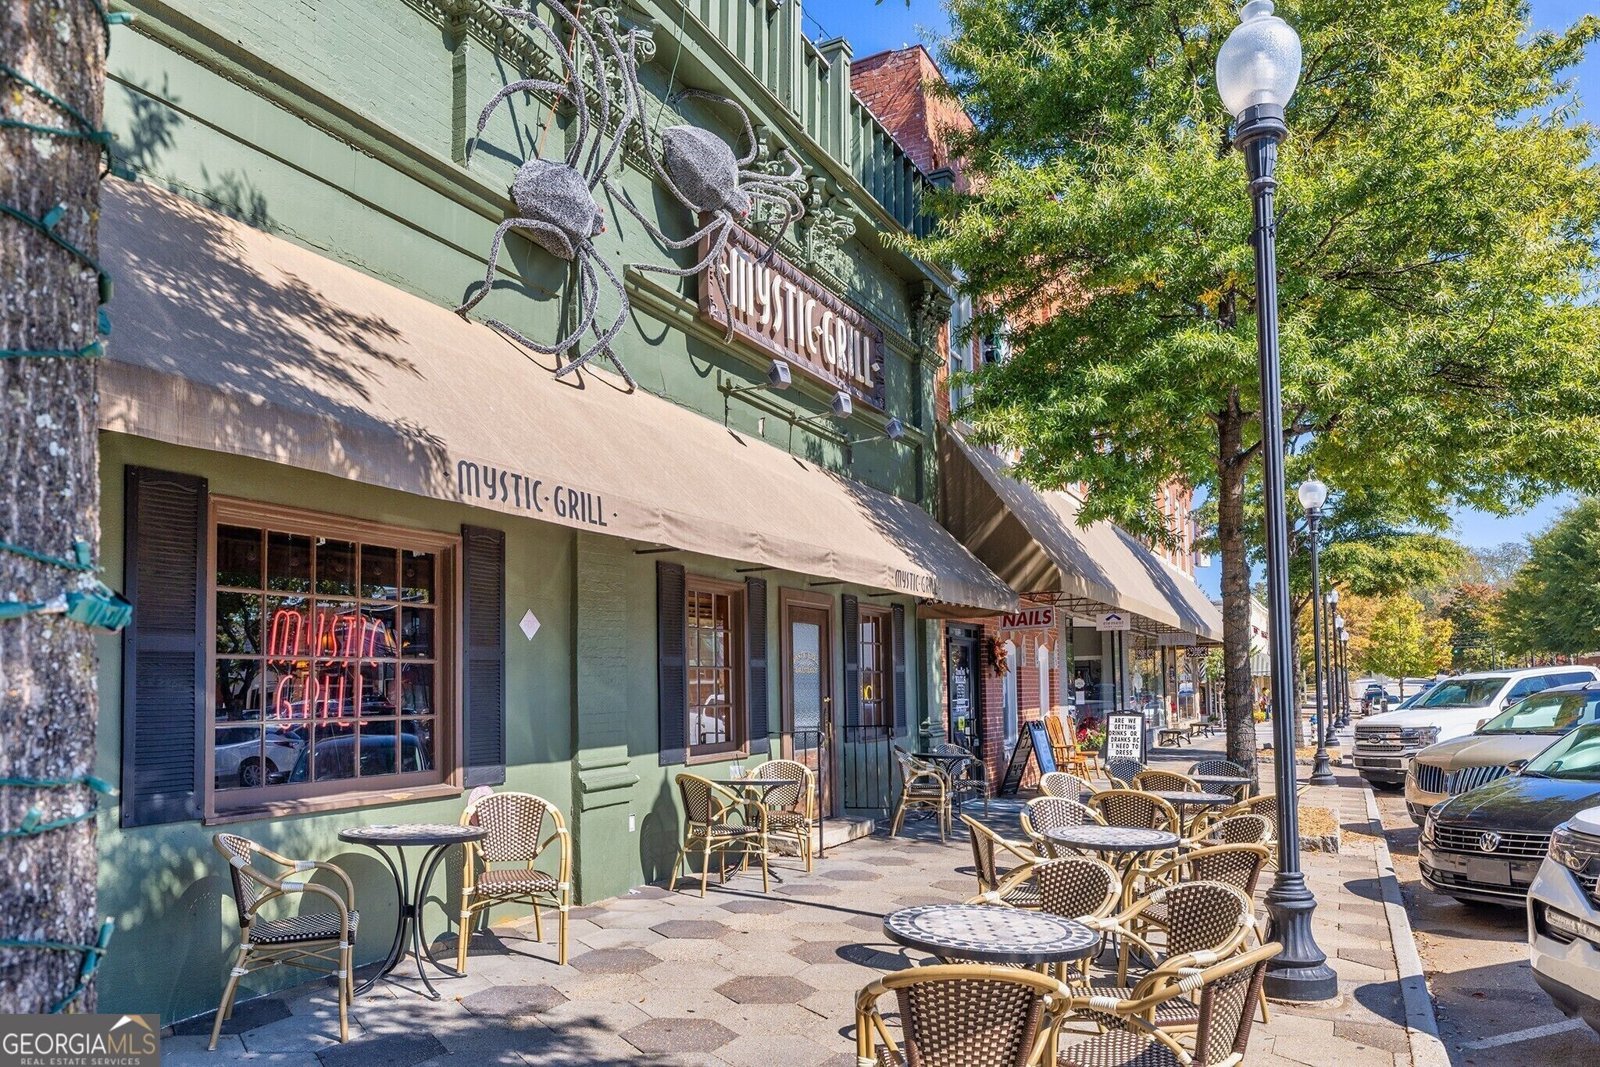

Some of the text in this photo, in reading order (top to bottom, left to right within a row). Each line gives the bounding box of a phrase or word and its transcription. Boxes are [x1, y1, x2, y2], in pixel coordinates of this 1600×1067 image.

[729, 247, 875, 389] MYSTIC GRILL
[457, 459, 608, 527] MYSTIC GRILL
[895, 569, 919, 592] MYSTIC
[1002, 609, 1052, 628] NAILS
